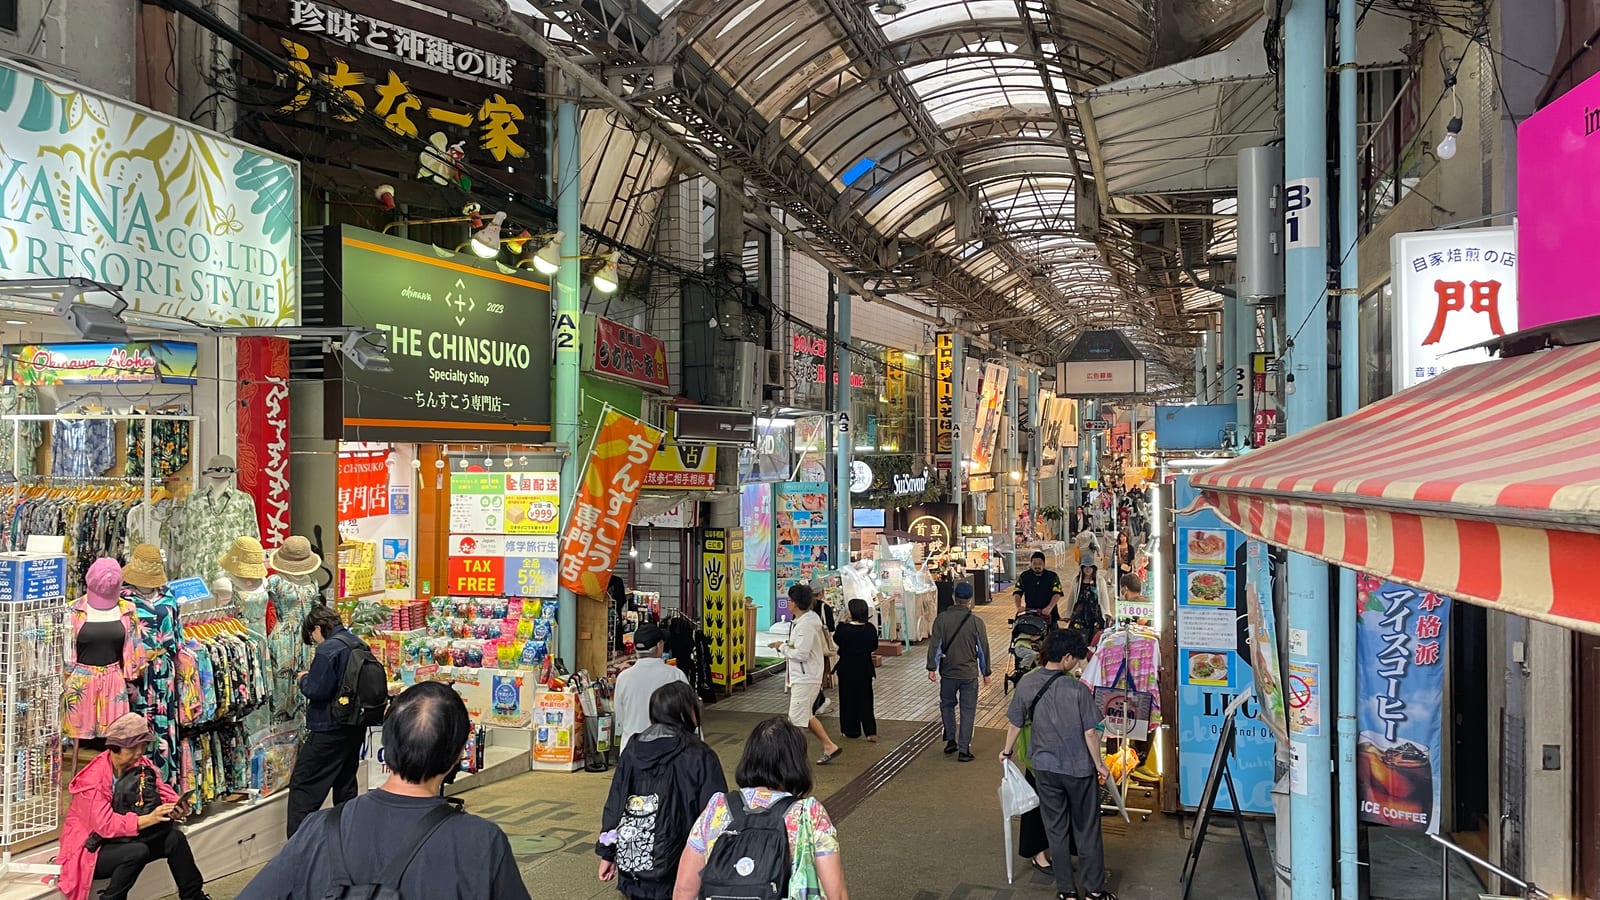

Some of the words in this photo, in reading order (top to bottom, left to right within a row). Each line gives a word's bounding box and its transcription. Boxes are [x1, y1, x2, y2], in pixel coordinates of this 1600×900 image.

[290, 0, 517, 86] 珍味と沖縄の味
[1412, 247, 1516, 274] 自家焙煎の店
[25, 236, 179, 298] RESORT
[190, 269, 276, 315] STYLE
[401, 285, 432, 302] okinawa
[486, 302, 505, 314] 2023
[1421, 279, 1505, 346] 門
[32, 351, 97, 371] Okinawa
[105, 347, 155, 369] Aloha
[428, 331, 530, 369] CHINSUKO
[429, 367, 468, 385] Specialty
[469, 371, 489, 387] Shop
[343, 462, 384, 474] CHINSUKO
[893, 469, 926, 495] SuiSavon
[338, 484, 387, 514] 専門店
[588, 434, 653, 572] ちんすこう
[530, 509, 552, 519] ¥999
[505, 540, 557, 553] 修学旅行生
[561, 502, 602, 582] 専門店
[463, 559, 491, 573] TAX
[518, 569, 545, 586] 5%
[457, 577, 496, 592] FREE
[521, 586, 540, 595] OFF
[1414, 591, 1443, 666] 本格派
[1377, 589, 1416, 742] アイスコーヒー
[1361, 800, 1380, 815] ICE
[1383, 806, 1427, 824] COFFEE
